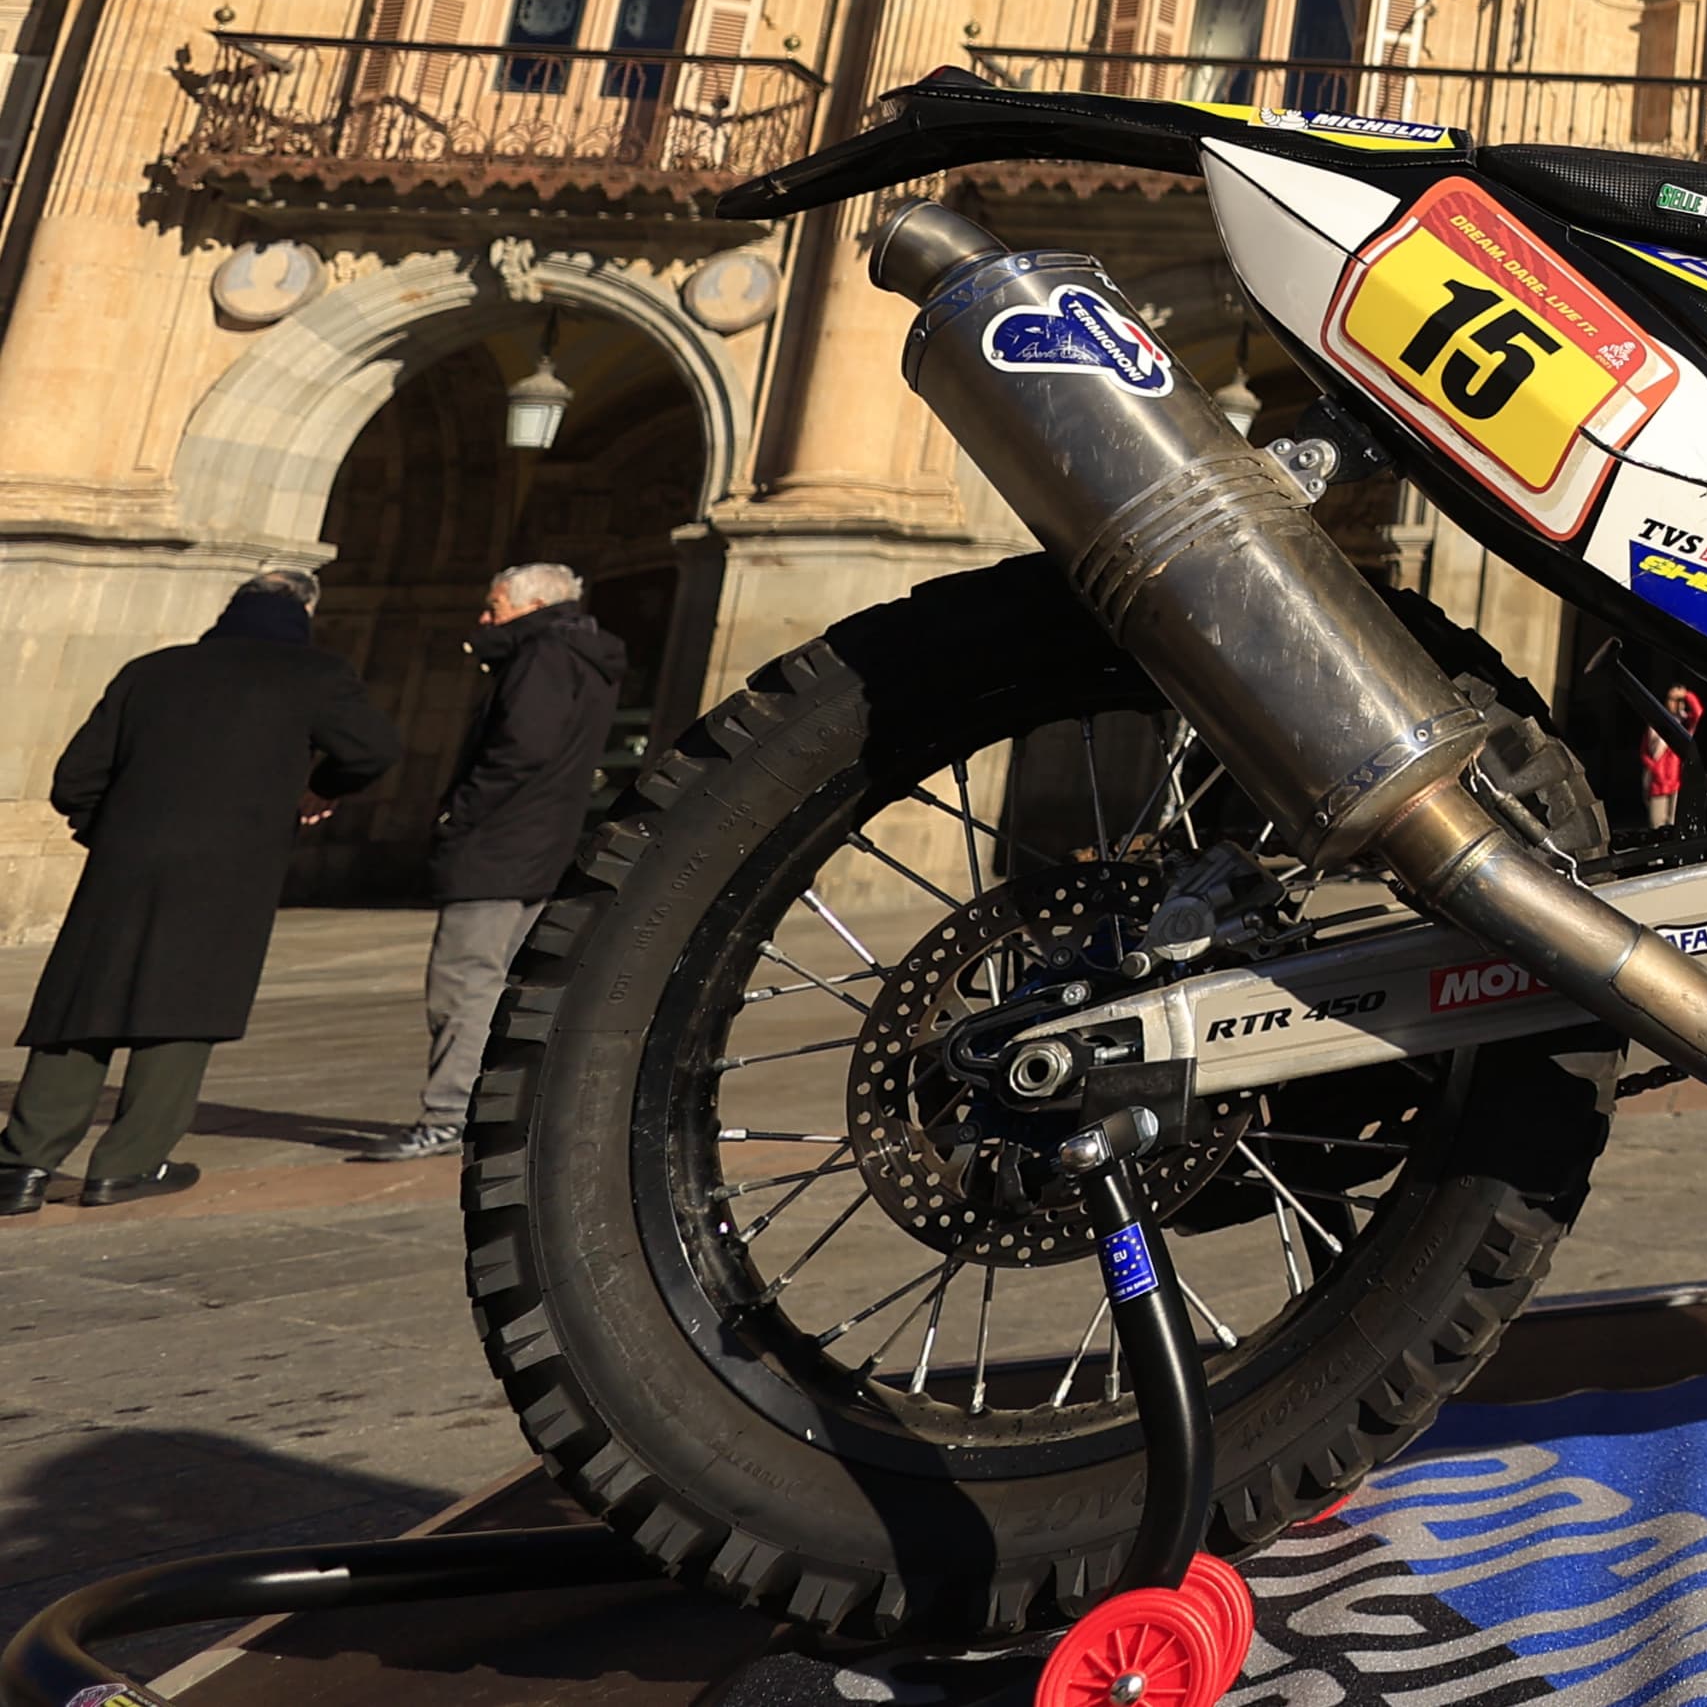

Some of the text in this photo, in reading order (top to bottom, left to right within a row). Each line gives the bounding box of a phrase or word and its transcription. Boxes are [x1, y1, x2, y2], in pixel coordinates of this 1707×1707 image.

[1312, 113, 1442, 139] MICHELIN
[1657, 184, 1702, 212] SELLE
[1450, 214, 1599, 337] DREAM. DARE. LIVE IT.
[1067, 299, 1146, 382] TERMIGNONI
[1399, 279, 1563, 420] 15
[1638, 518, 1704, 555] TVS
[1438, 963, 1550, 1006] MOT
[1206, 989, 1387, 1043] RTR 450
